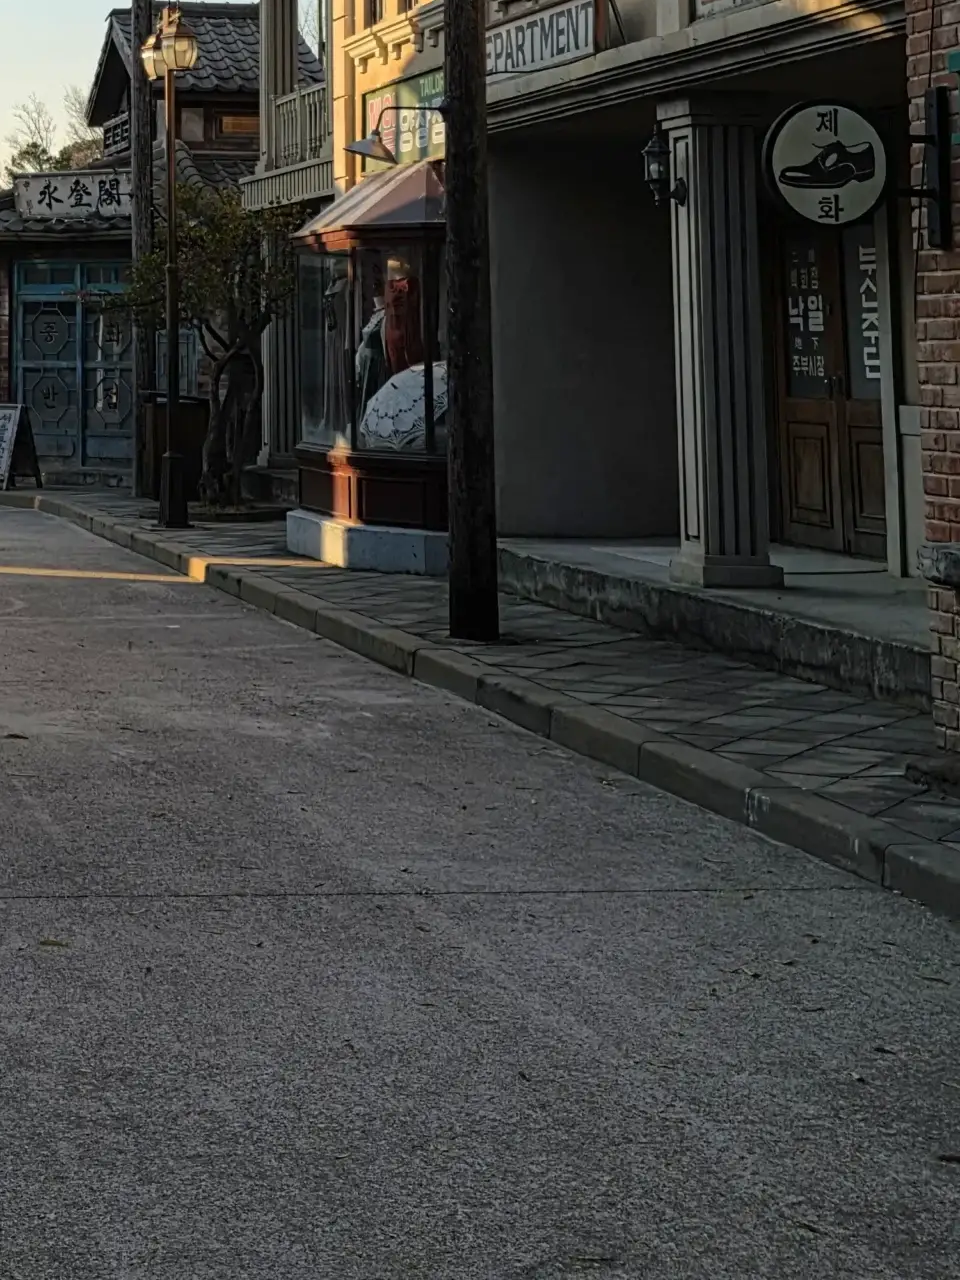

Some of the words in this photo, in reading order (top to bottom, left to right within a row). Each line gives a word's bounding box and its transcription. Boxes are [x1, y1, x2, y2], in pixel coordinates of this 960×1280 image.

[816, 108, 839, 136] 제
[818, 194, 844, 222] 화
[793, 355, 825, 377] 주부시장
